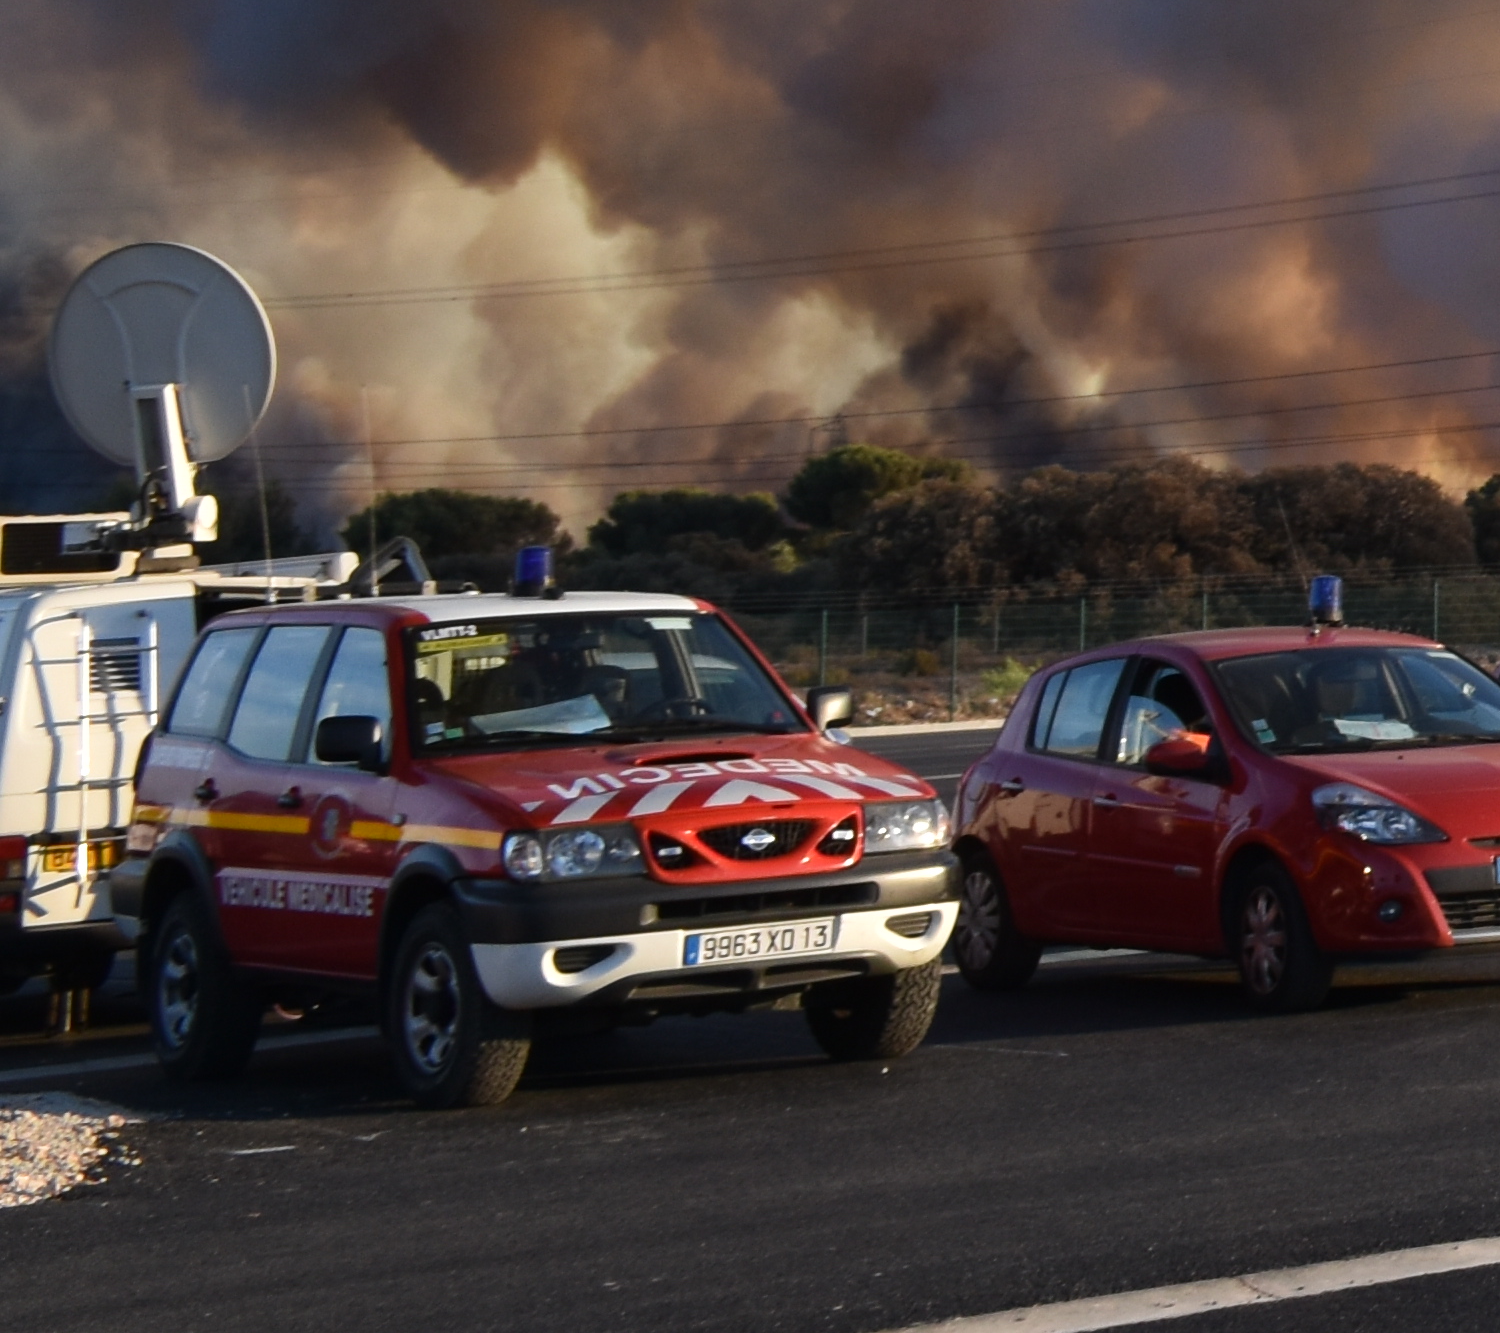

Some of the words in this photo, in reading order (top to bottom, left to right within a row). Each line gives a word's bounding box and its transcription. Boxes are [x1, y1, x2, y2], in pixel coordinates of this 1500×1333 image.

[221, 876, 285, 909] VEHICULE
[287, 881, 375, 917] MEDICALISE
[703, 932, 761, 960] 9963
[804, 925, 828, 949] 13
